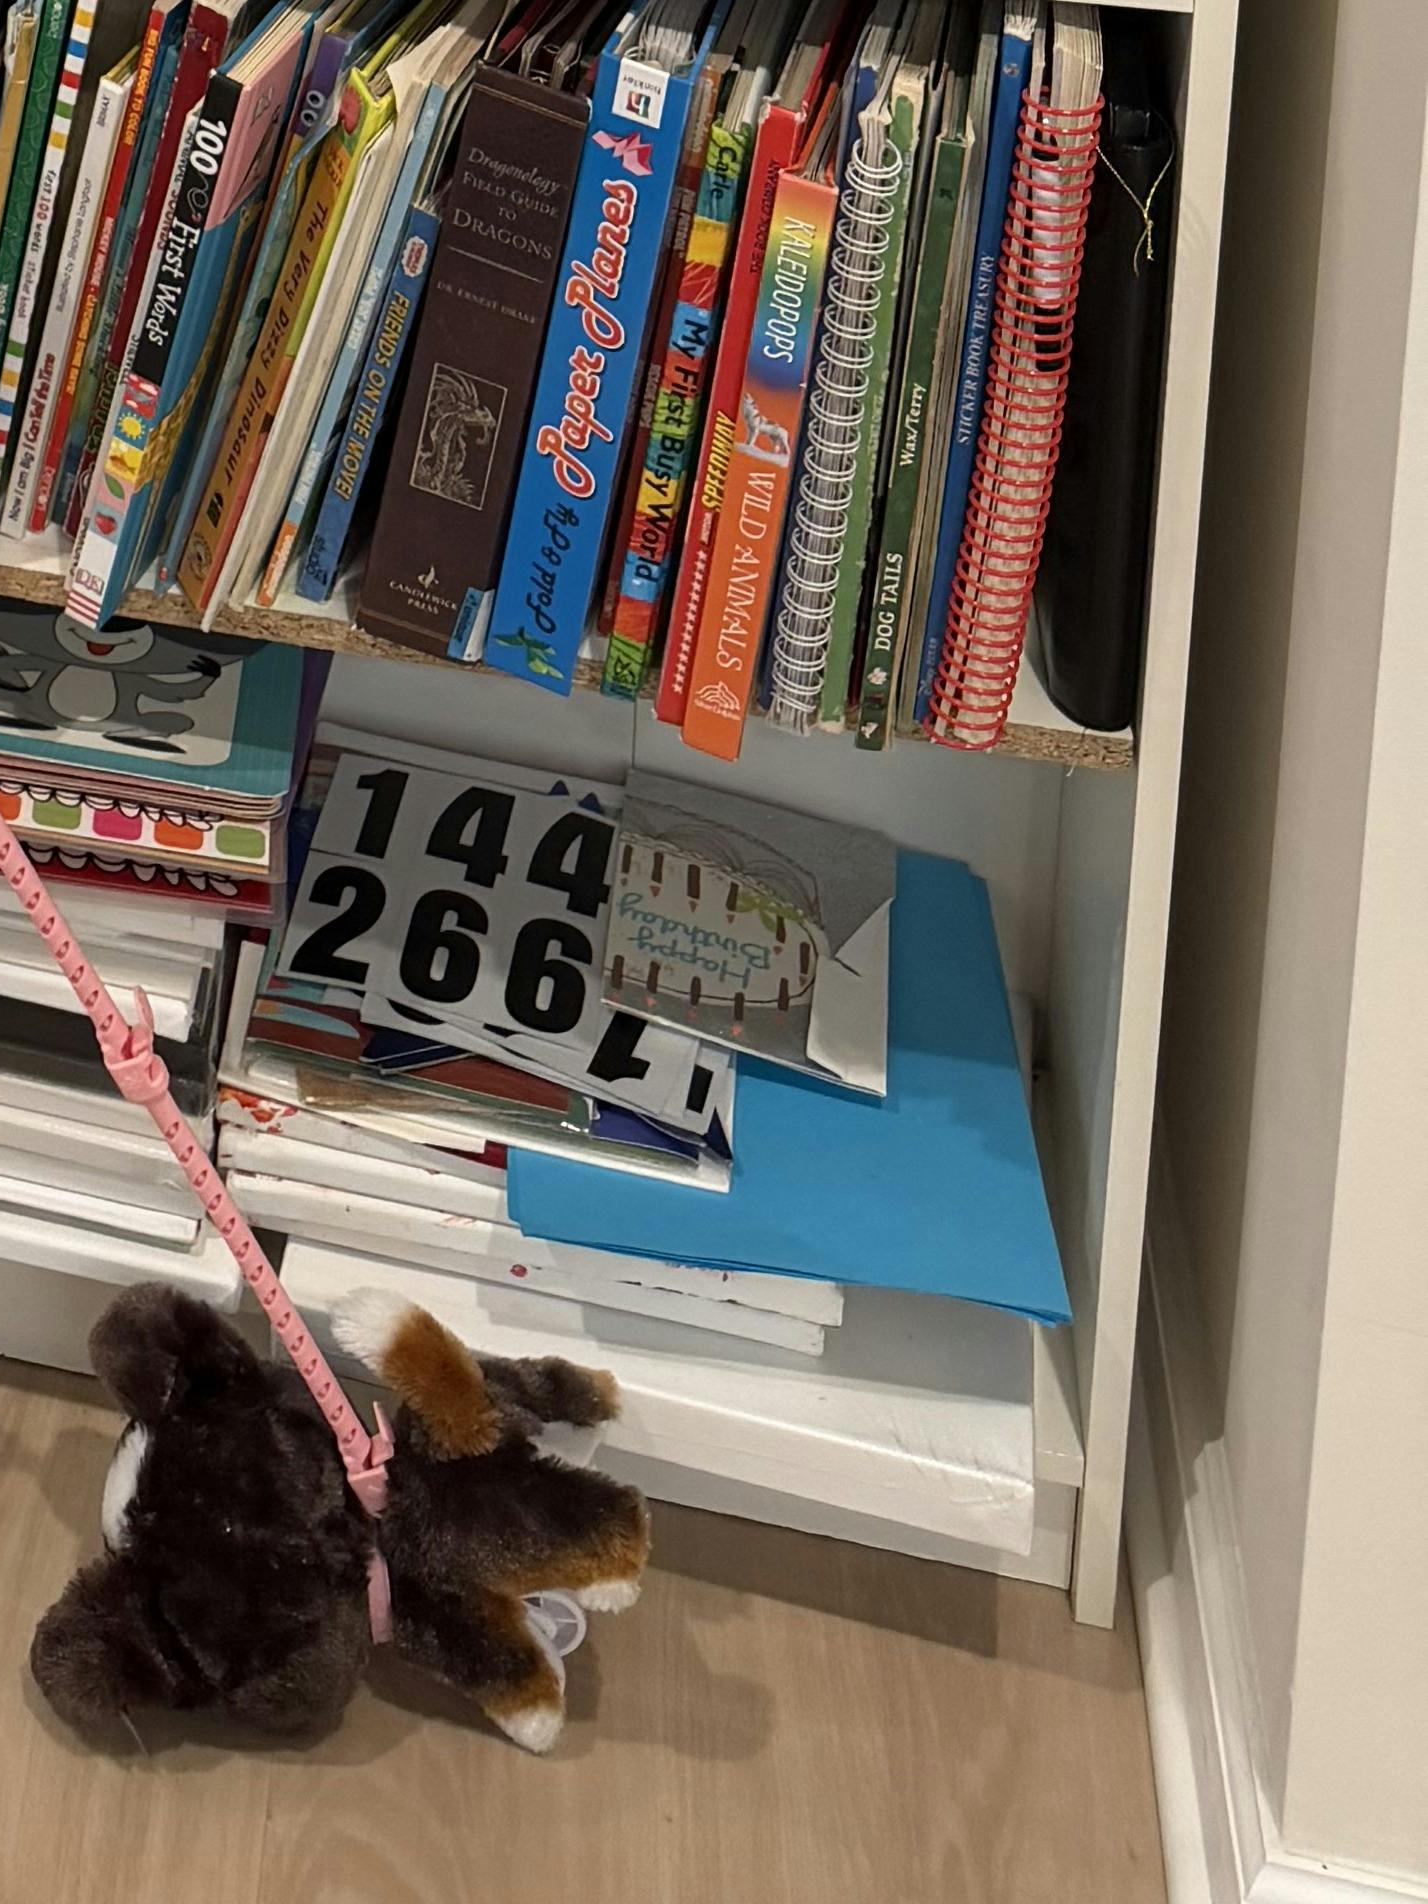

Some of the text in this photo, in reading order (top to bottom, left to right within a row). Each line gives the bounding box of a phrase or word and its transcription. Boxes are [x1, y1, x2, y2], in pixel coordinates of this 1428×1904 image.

[144, 117, 227, 346] 100 First Words
[451, 208, 553, 261] DRAGONS
[710, 144, 738, 201] Carle
[222, 199, 330, 490] The Very Dizzy Dinosaur
[334, 290, 411, 501] FRIENDS ON THE MOVE!
[536, 180, 637, 500] Paper Planes
[634, 319, 708, 583] My First Busy World
[702, 411, 736, 512] SPEEDWAY
[716, 217, 816, 671] KALEIDOPOPS WILD ANIMALS
[897, 381, 924, 468] Wax/Terry
[875, 551, 902, 652] DOG TAILS
[354, 768, 616, 918] 144
[288, 864, 594, 1035] 266
[616, 889, 774, 971] Birthday
[625, 927, 752, 990] Happy
